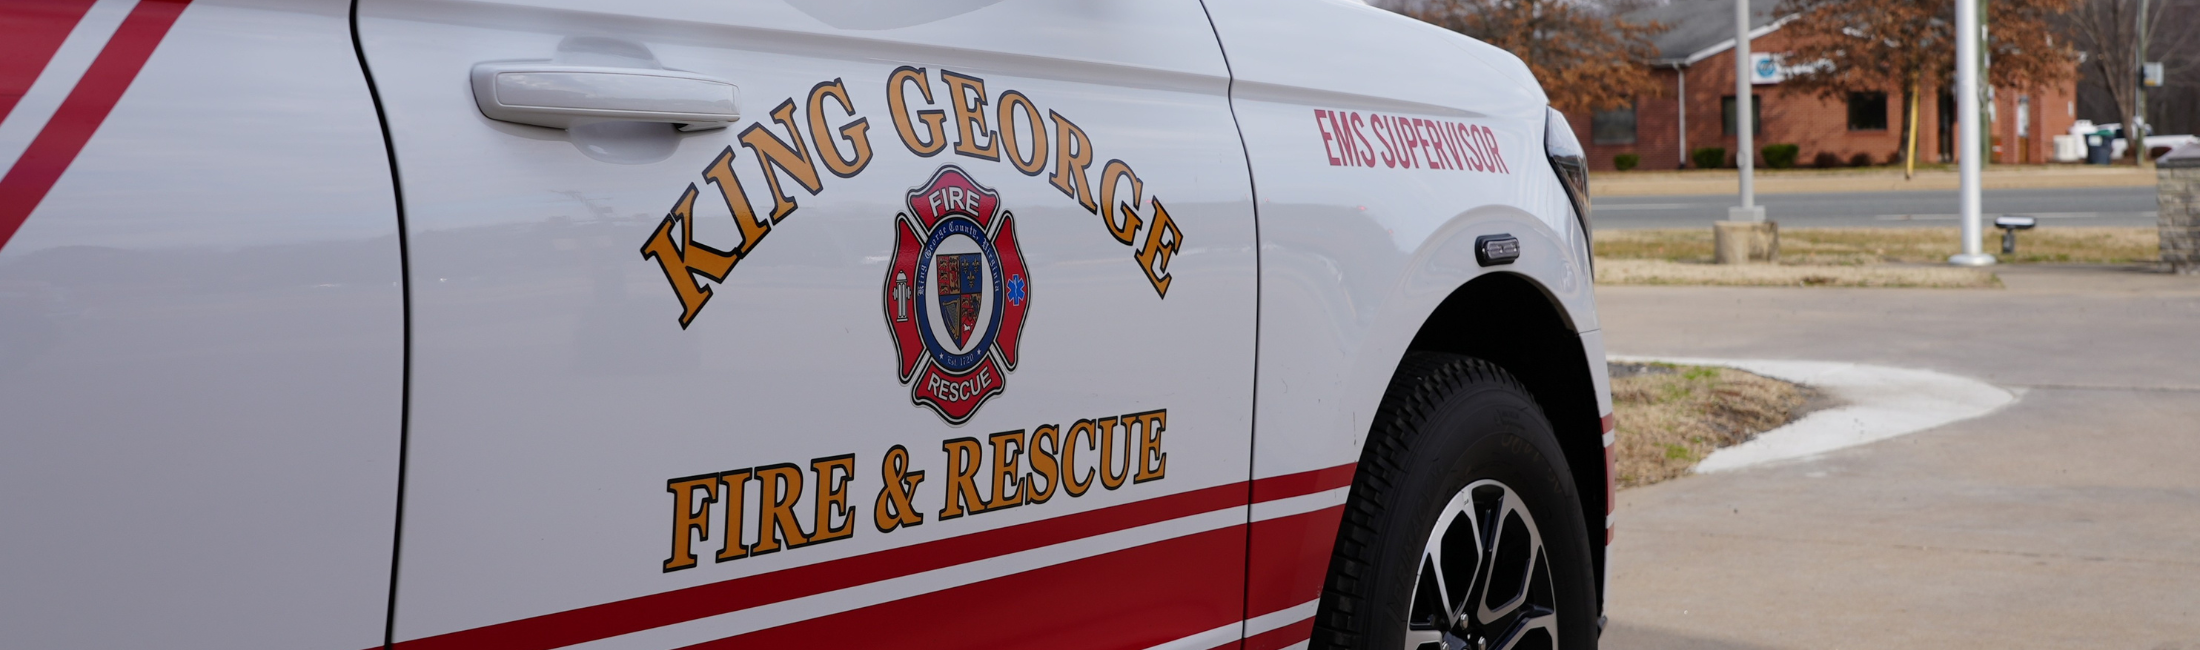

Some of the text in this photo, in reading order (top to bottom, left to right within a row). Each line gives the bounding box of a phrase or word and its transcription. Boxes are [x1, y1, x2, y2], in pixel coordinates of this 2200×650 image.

[1314, 109, 1510, 174] EMS SUPERVISOR
[640, 65, 1183, 330] KING GEORGE
[928, 186, 980, 217] FIRE
[917, 221, 1000, 296] King George County, Virginia
[927, 366, 992, 402] RESCUE
[960, 354, 974, 366] 1720
[663, 409, 1167, 573] FIRE & RESCUE
